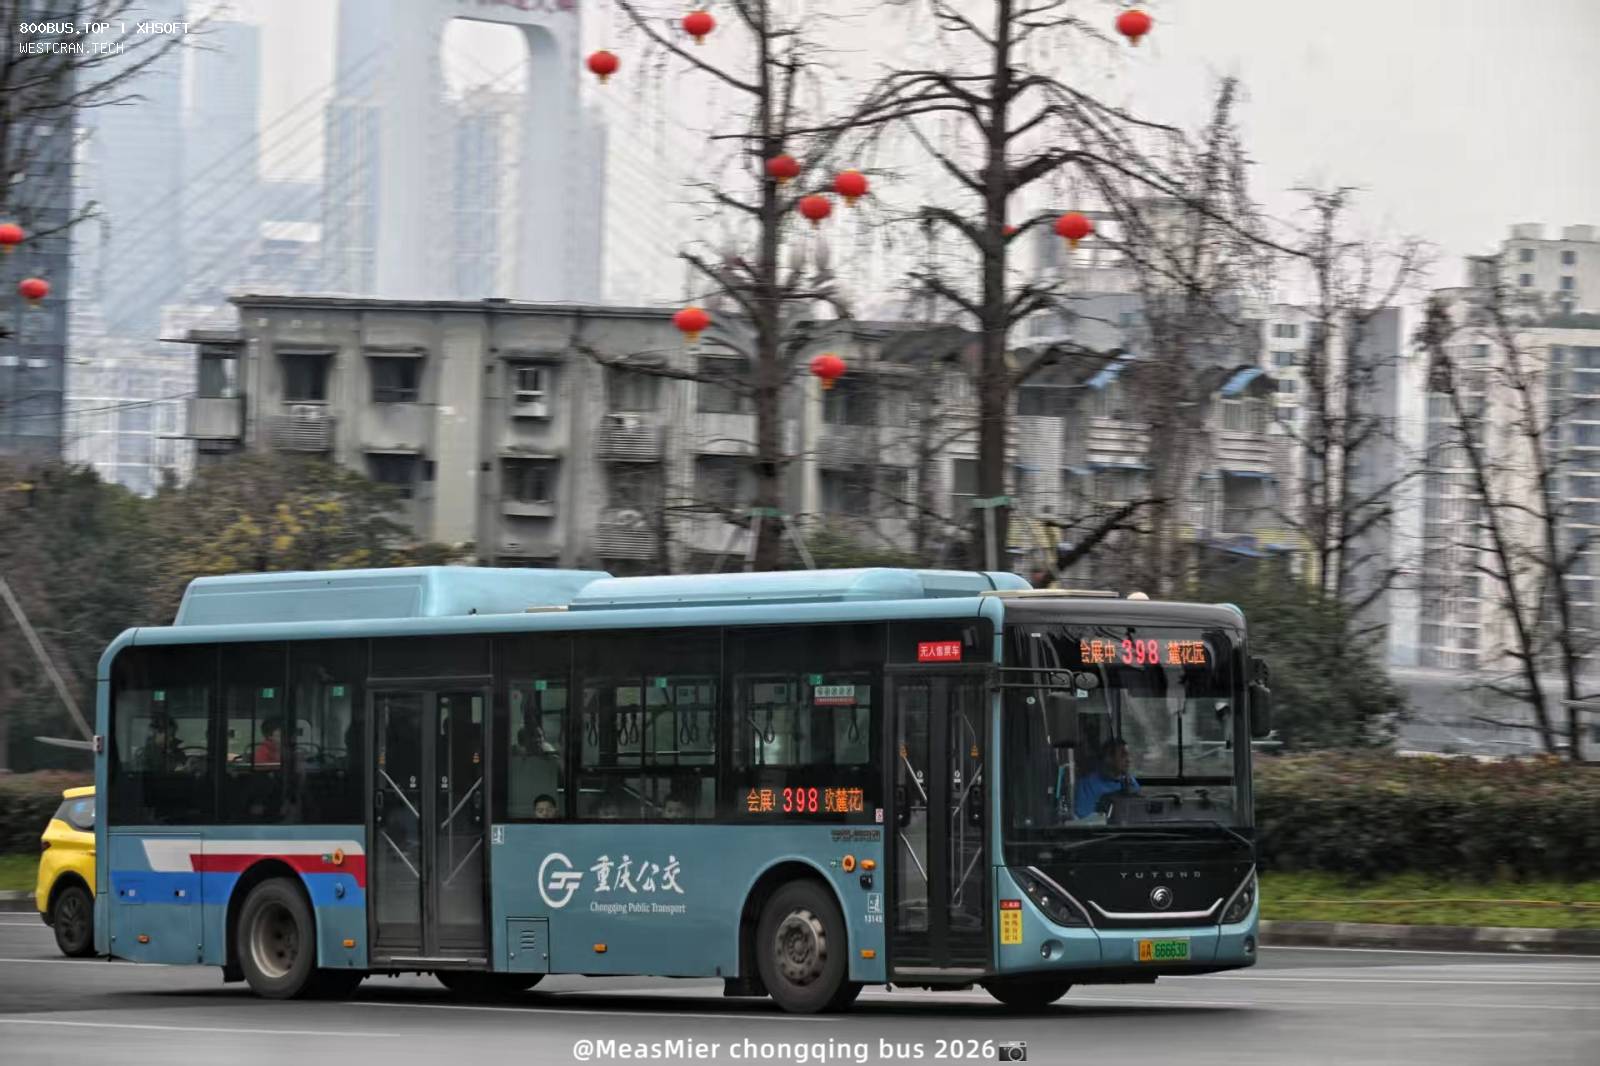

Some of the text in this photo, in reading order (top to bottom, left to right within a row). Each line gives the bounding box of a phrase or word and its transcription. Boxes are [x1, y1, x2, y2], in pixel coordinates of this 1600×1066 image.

[1121, 639, 1159, 665] 398
[783, 787, 818, 813] 398
[590, 854, 685, 894] 重庆公交
[590, 901, 686, 915] Chongqing Public Transport
